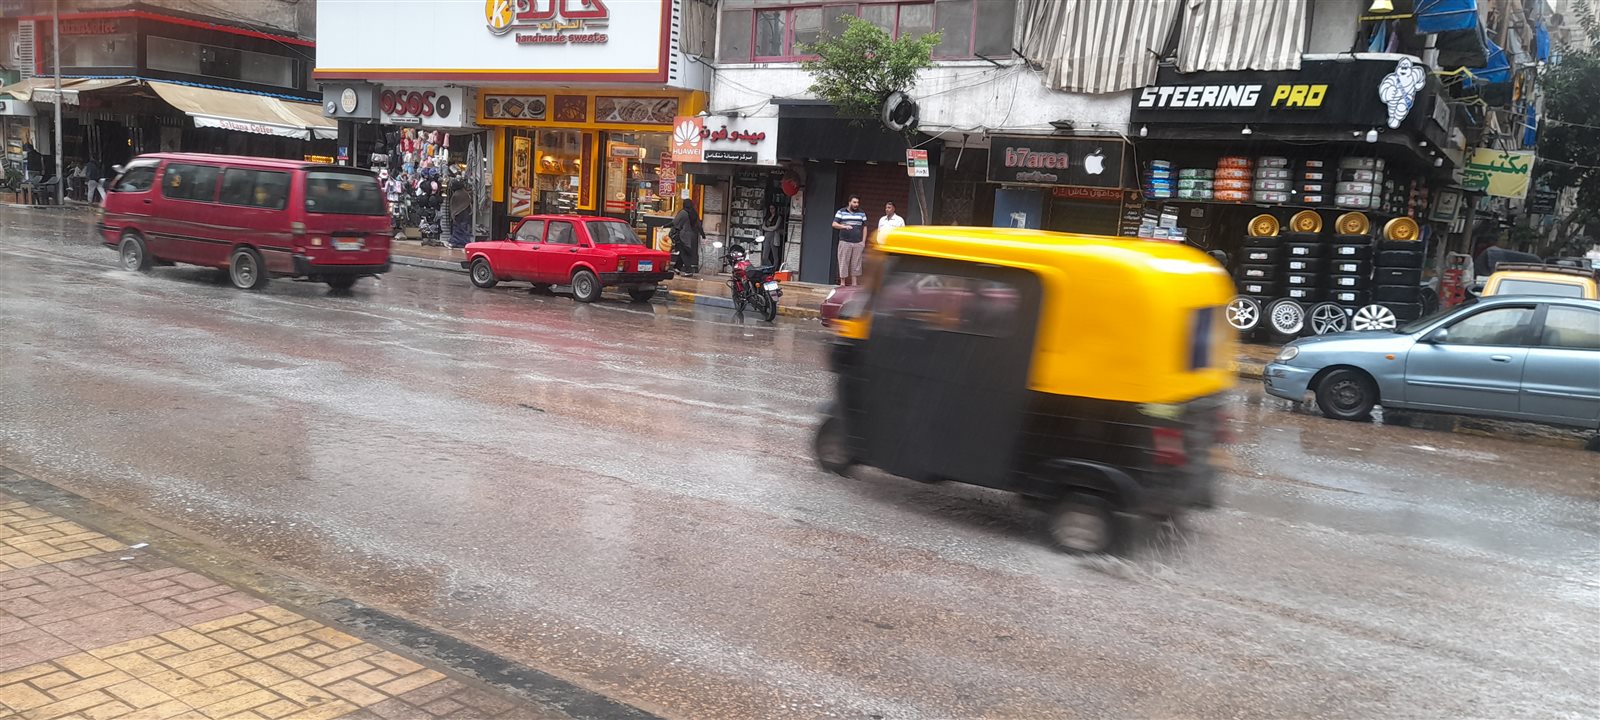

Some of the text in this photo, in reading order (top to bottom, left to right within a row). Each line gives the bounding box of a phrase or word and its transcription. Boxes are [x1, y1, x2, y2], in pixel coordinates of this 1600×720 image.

[515, 33, 608, 44] handmade sweets
[1138, 84, 1328, 108] STEERING PRO
[251, 123, 274, 133] Coffee
[672, 148, 701, 156] HUAWEI
[1005, 147, 1070, 169] b7area
